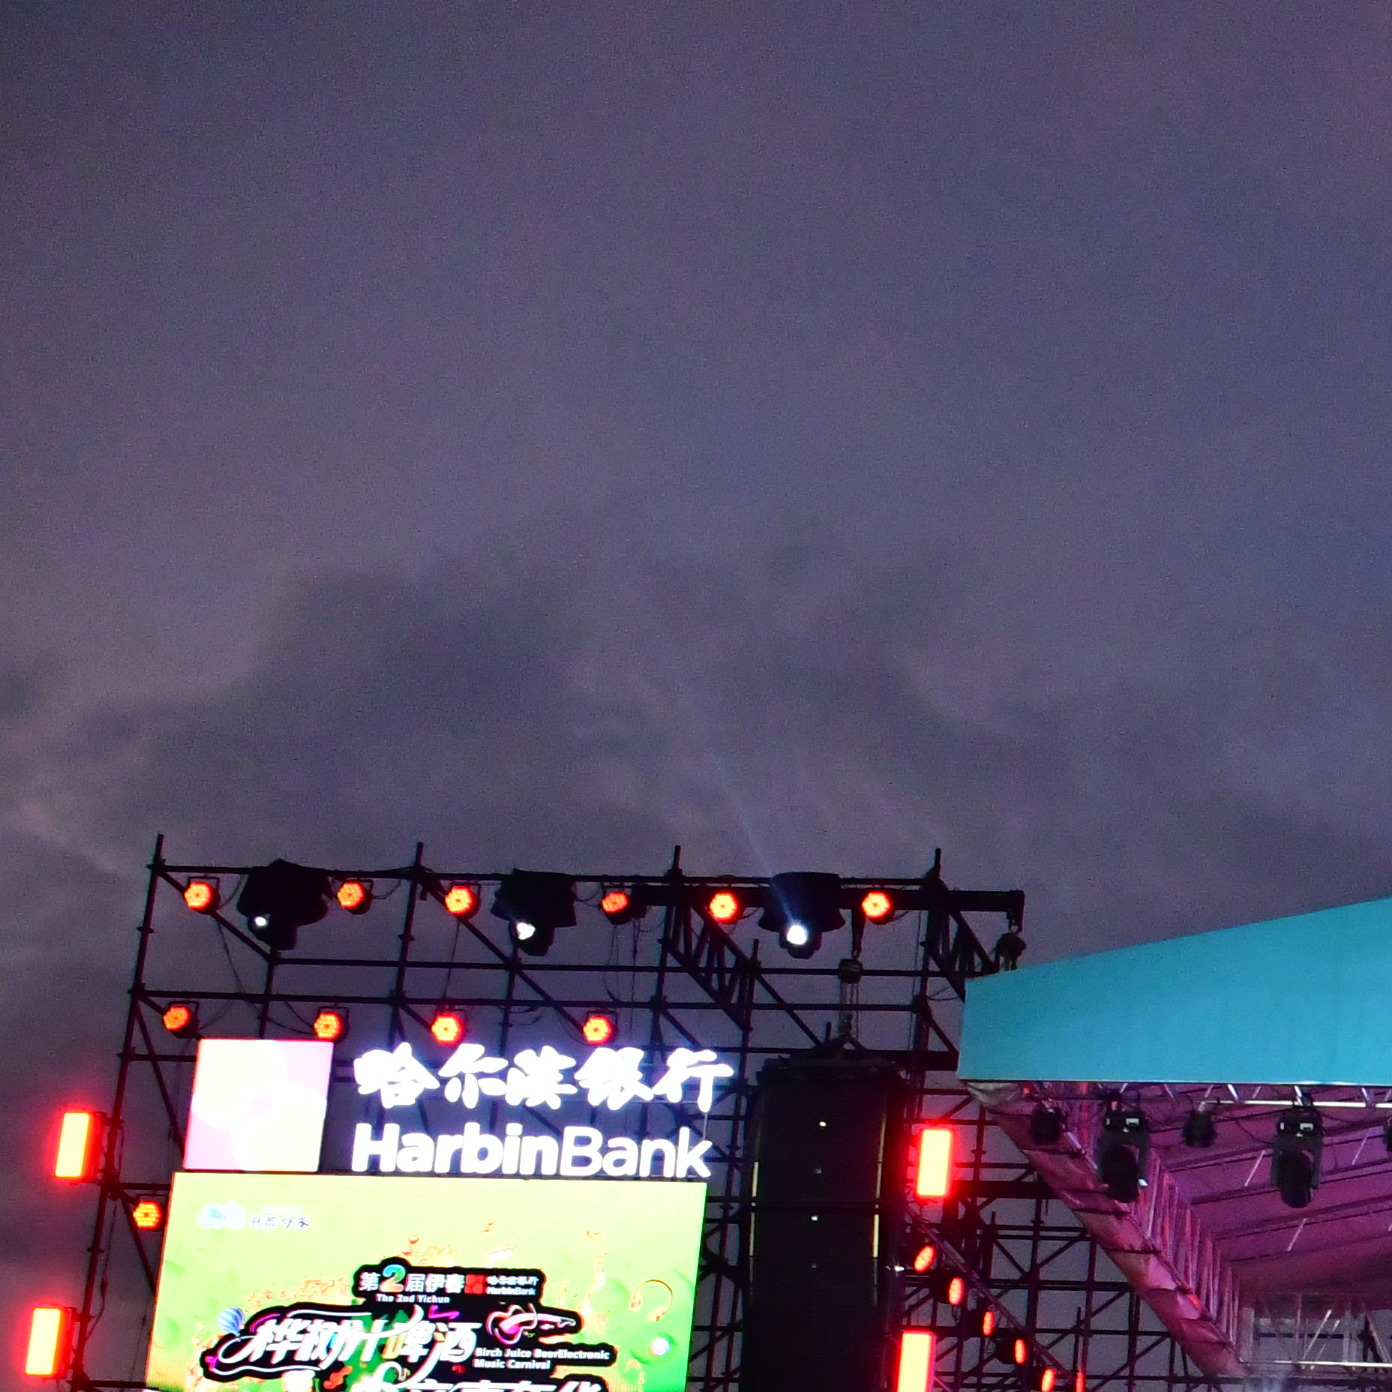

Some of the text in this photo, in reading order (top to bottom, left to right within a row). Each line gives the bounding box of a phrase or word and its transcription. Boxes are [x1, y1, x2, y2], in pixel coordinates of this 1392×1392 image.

[354, 1043, 734, 1112] 哈尔滨银行
[351, 1122, 712, 1178] HarbinBank
[376, 1293, 394, 1303] The
[397, 1294, 415, 1303] 2nd
[475, 1347, 502, 1358] Birch
[505, 1348, 532, 1358] Juice
[474, 1358, 551, 1370] Music Carnival
